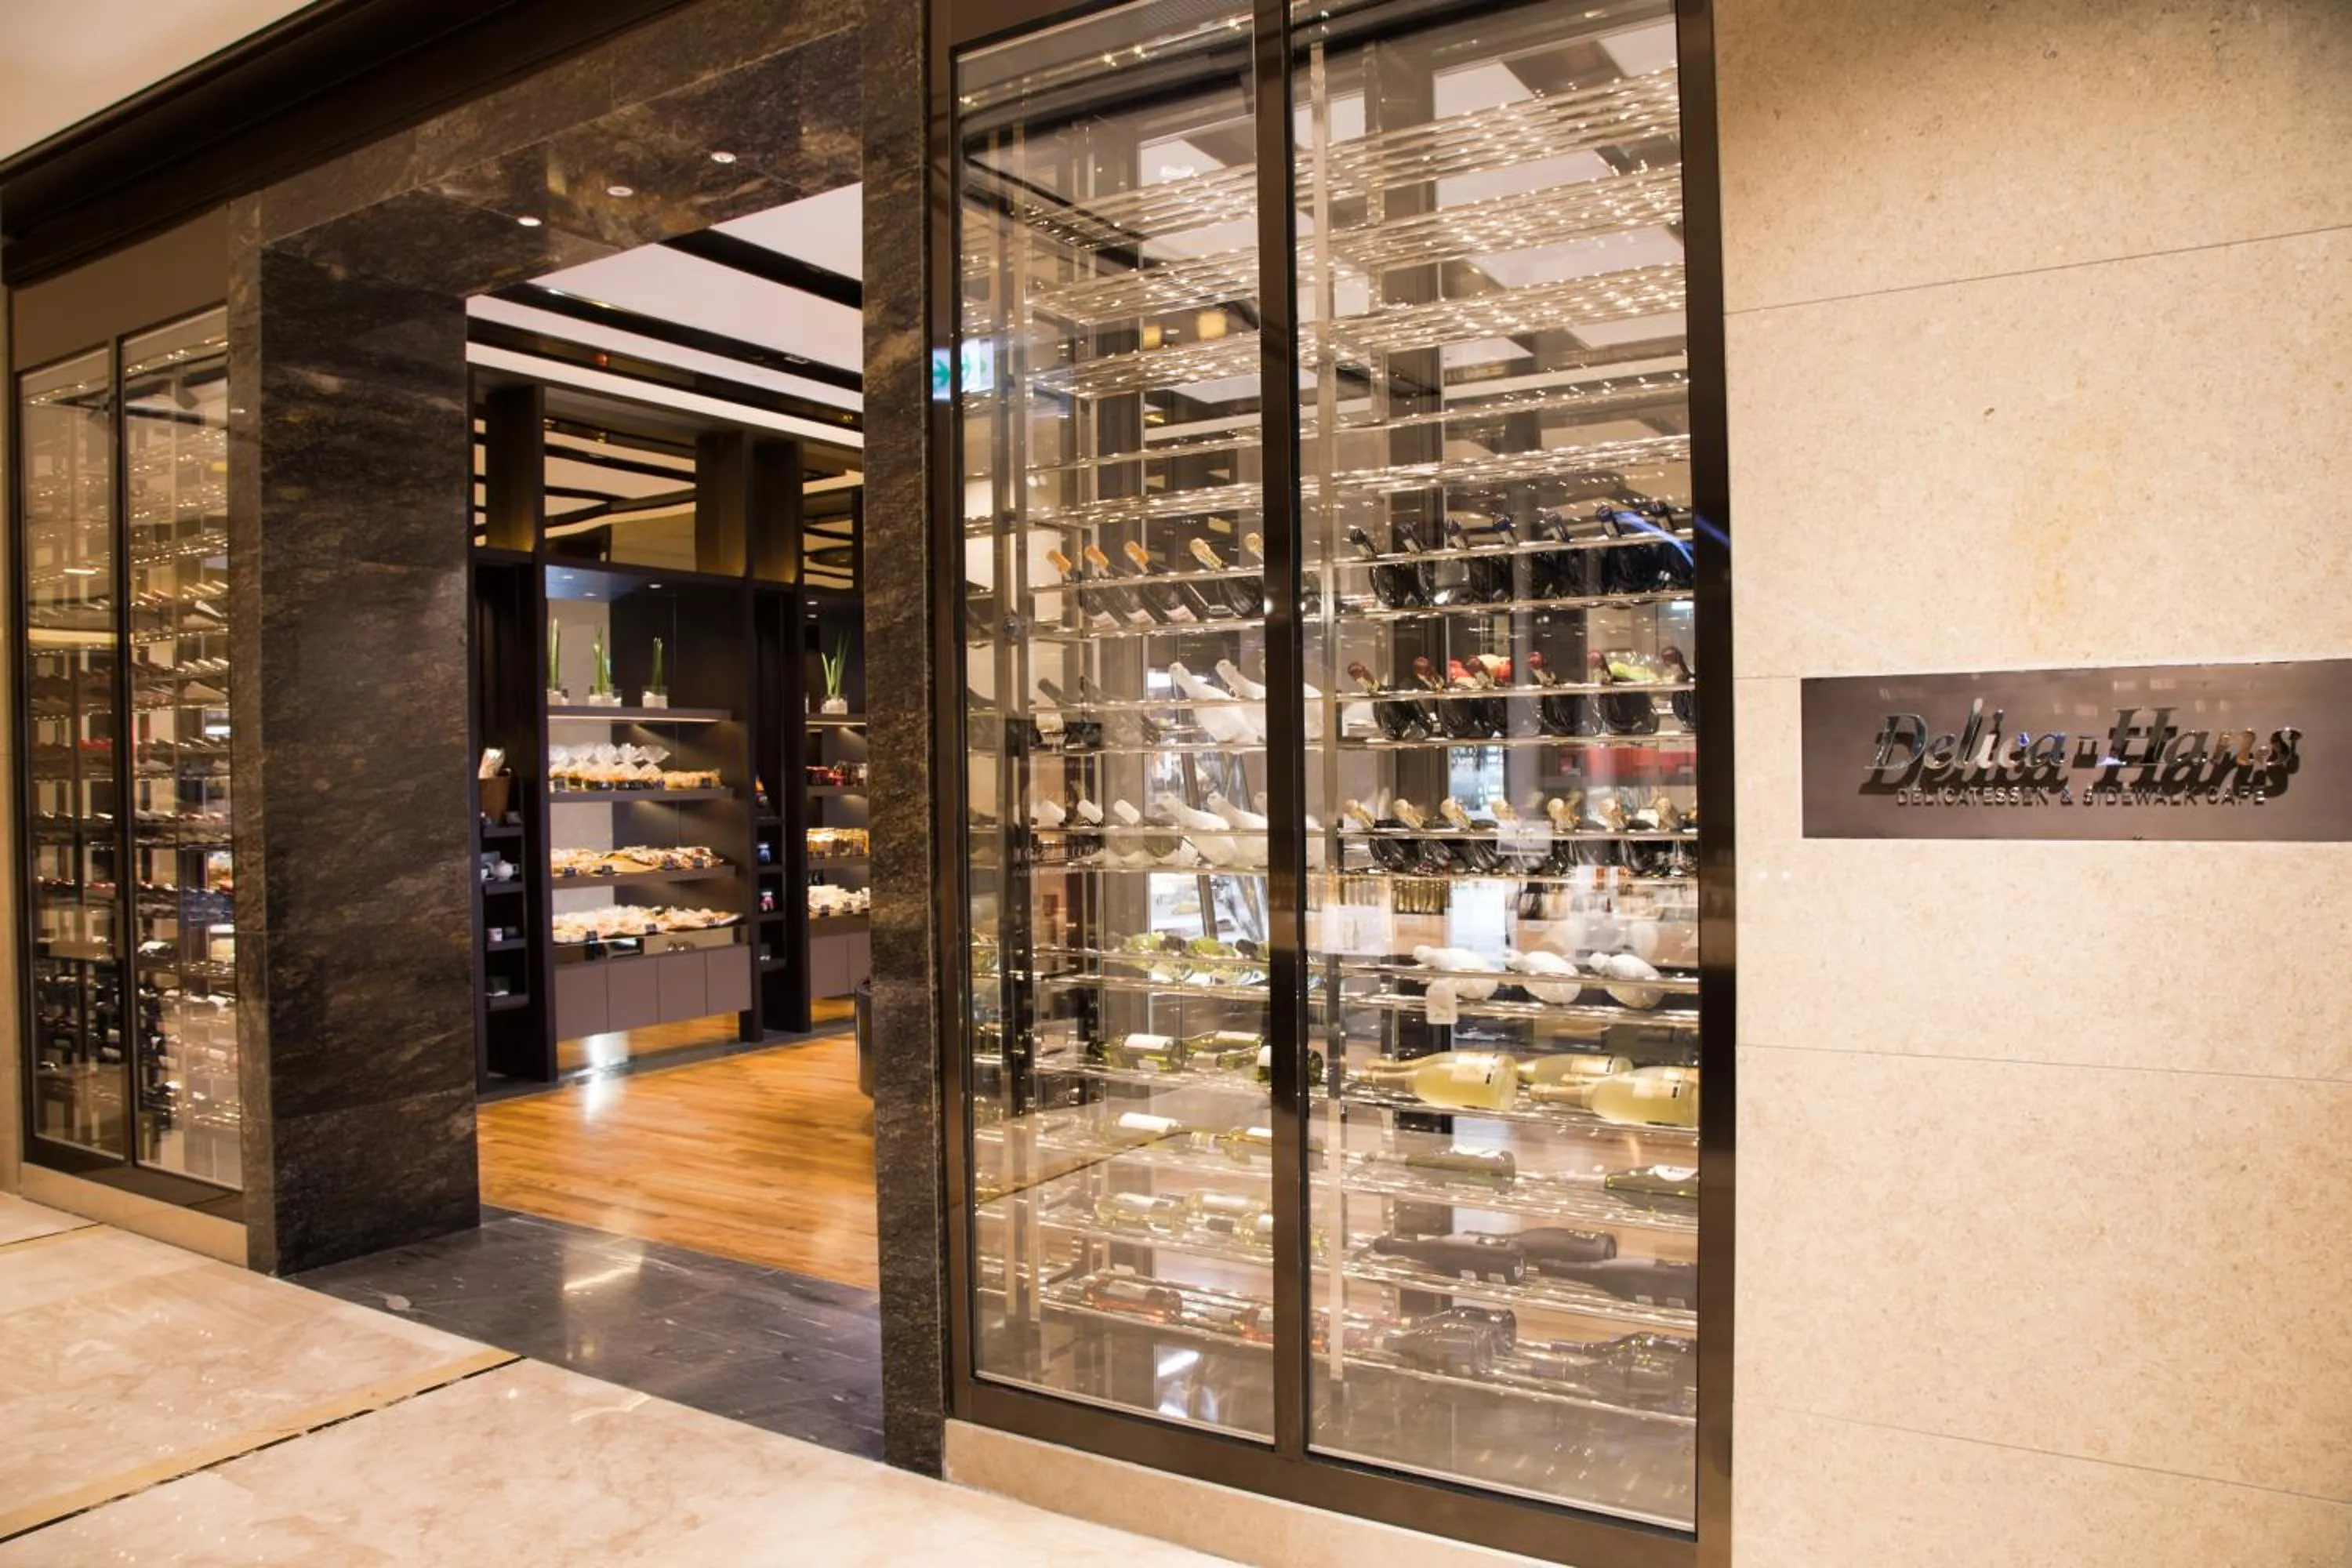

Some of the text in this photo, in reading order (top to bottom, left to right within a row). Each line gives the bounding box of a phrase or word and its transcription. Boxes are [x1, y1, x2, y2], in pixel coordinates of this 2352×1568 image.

[1896, 784, 2266, 805] DELICATESSEN & SIDEWALK CAFE
